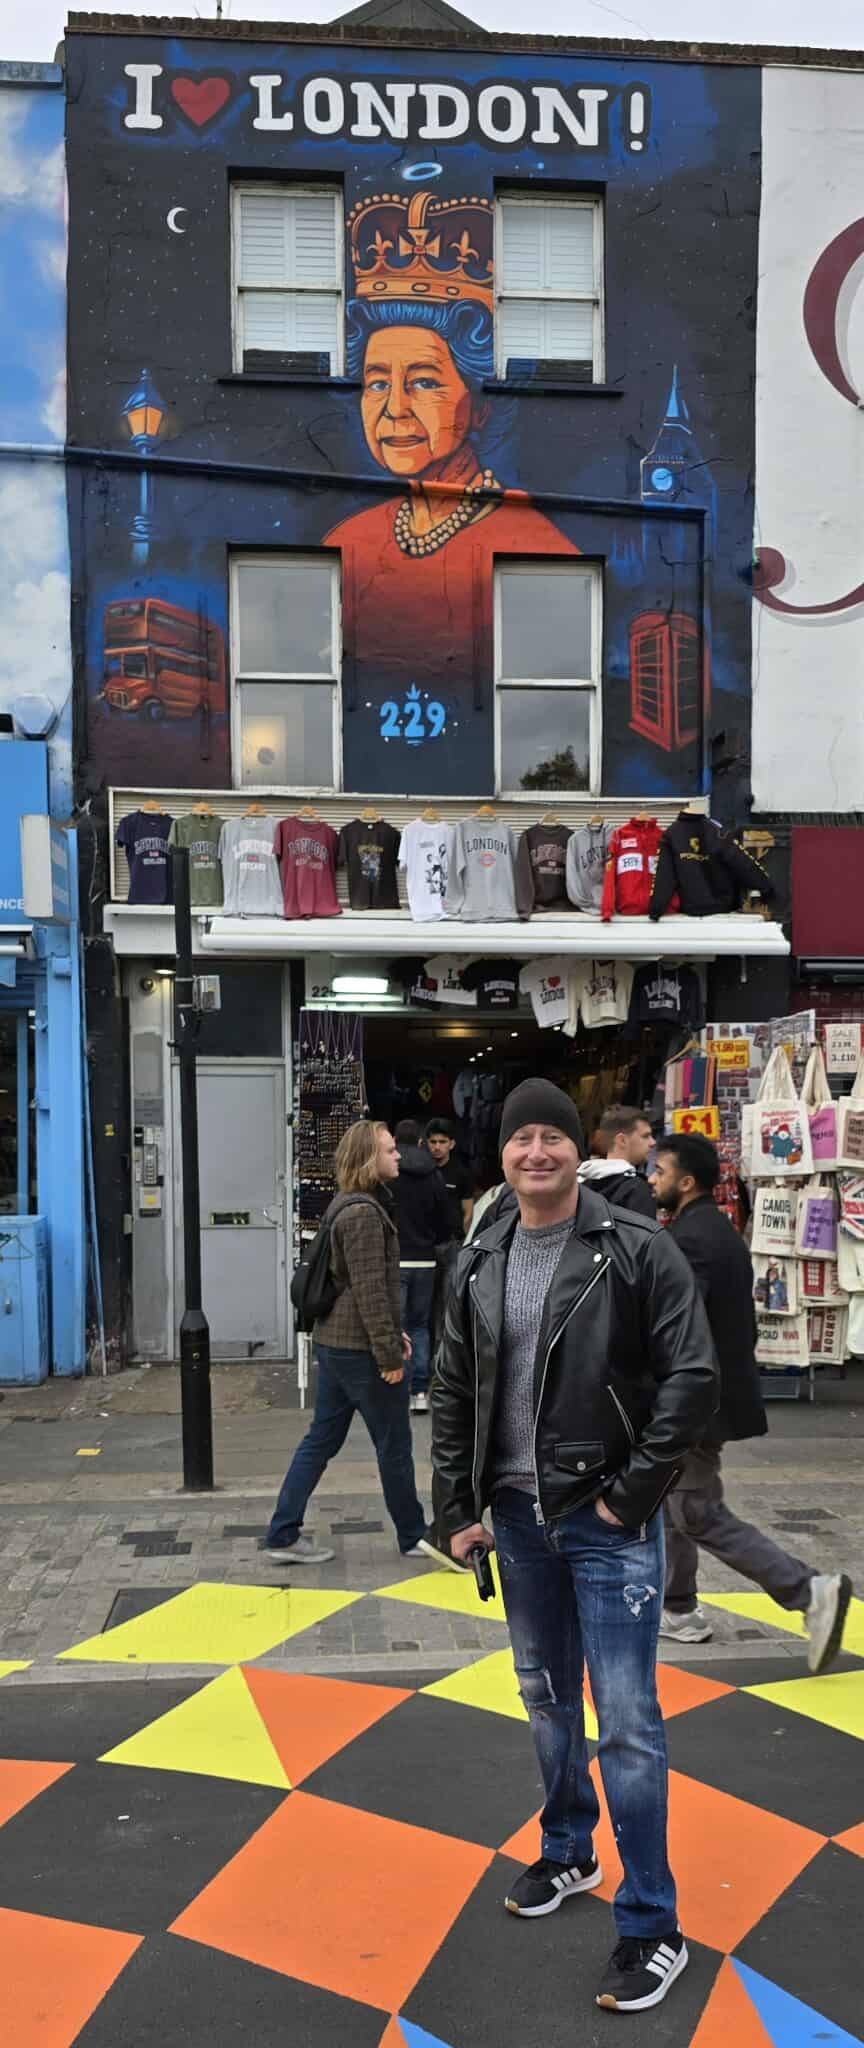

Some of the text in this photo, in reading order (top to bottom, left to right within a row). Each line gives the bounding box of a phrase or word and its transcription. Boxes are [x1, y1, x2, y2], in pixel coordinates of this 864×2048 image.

[124, 64, 163, 129] I
[249, 75, 609, 146] LONDON
[380, 701, 446, 737] 229
[464, 838, 508, 855] LONDON
[681, 1113, 712, 1136] £1
[761, 1214, 786, 1229] TOWN
